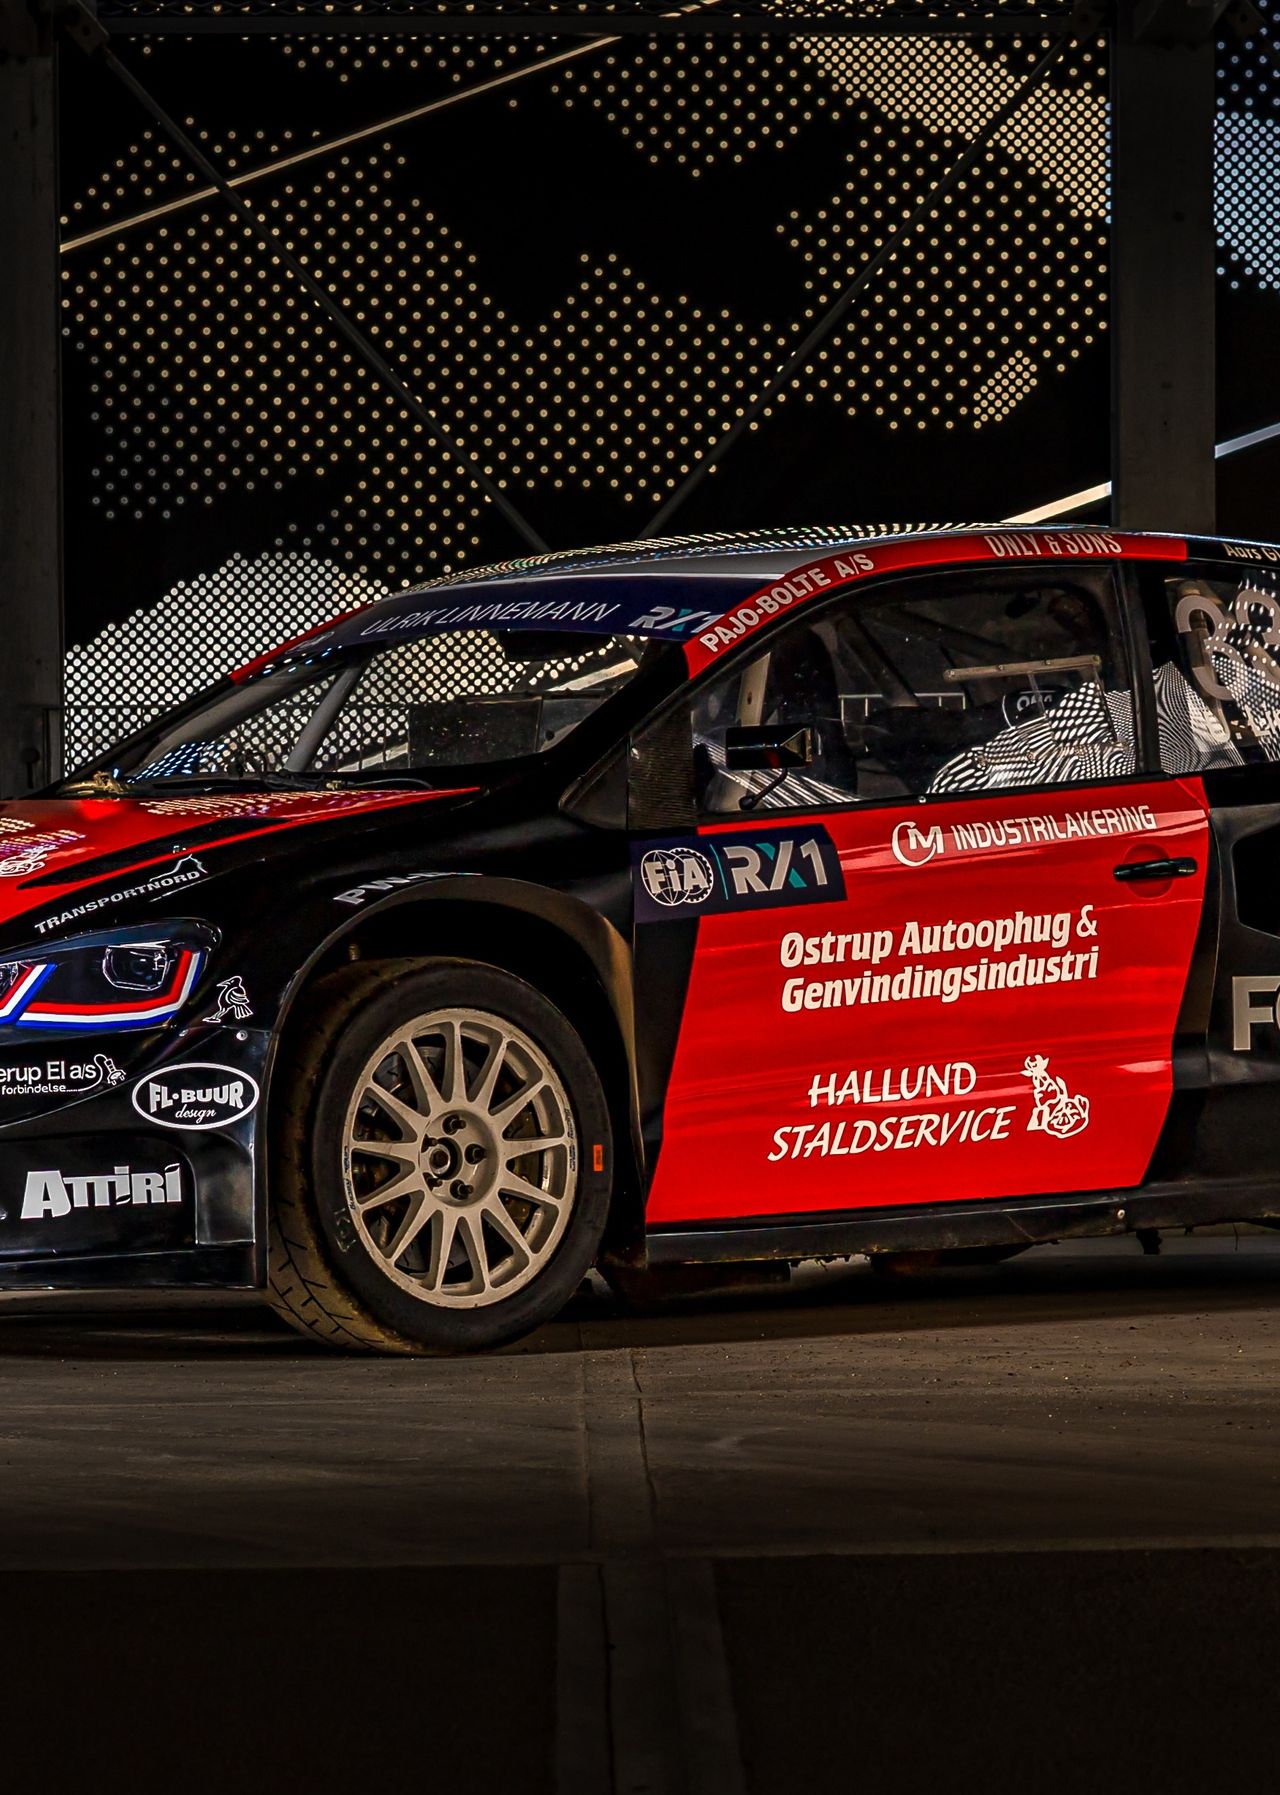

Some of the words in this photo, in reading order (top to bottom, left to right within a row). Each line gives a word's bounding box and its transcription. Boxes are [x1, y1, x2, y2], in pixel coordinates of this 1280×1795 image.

[984, 533, 1042, 557] ONLY
[1044, 534, 1063, 554] &
[1058, 533, 1122, 554] SONS
[360, 607, 447, 636] ULRIK
[434, 600, 621, 625] LINNEMANN
[700, 568, 832, 652] PAJO-BOLTE
[833, 553, 874, 578] A/S
[950, 804, 1158, 851] INDUSTRILAKERING
[723, 839, 828, 894] RX1
[34, 870, 201, 934] TRANSPORTNORD
[780, 929, 894, 968] Østrup
[898, 911, 1071, 956] Autoophug
[1076, 904, 1098, 937] &
[781, 946, 1100, 1013] Genvindingsindustri
[70, 1064, 96, 1079] a/s
[808, 1062, 977, 1107] HALLUND
[175, 1104, 217, 1124] design
[767, 1105, 1017, 1162] STALDSERVICE
